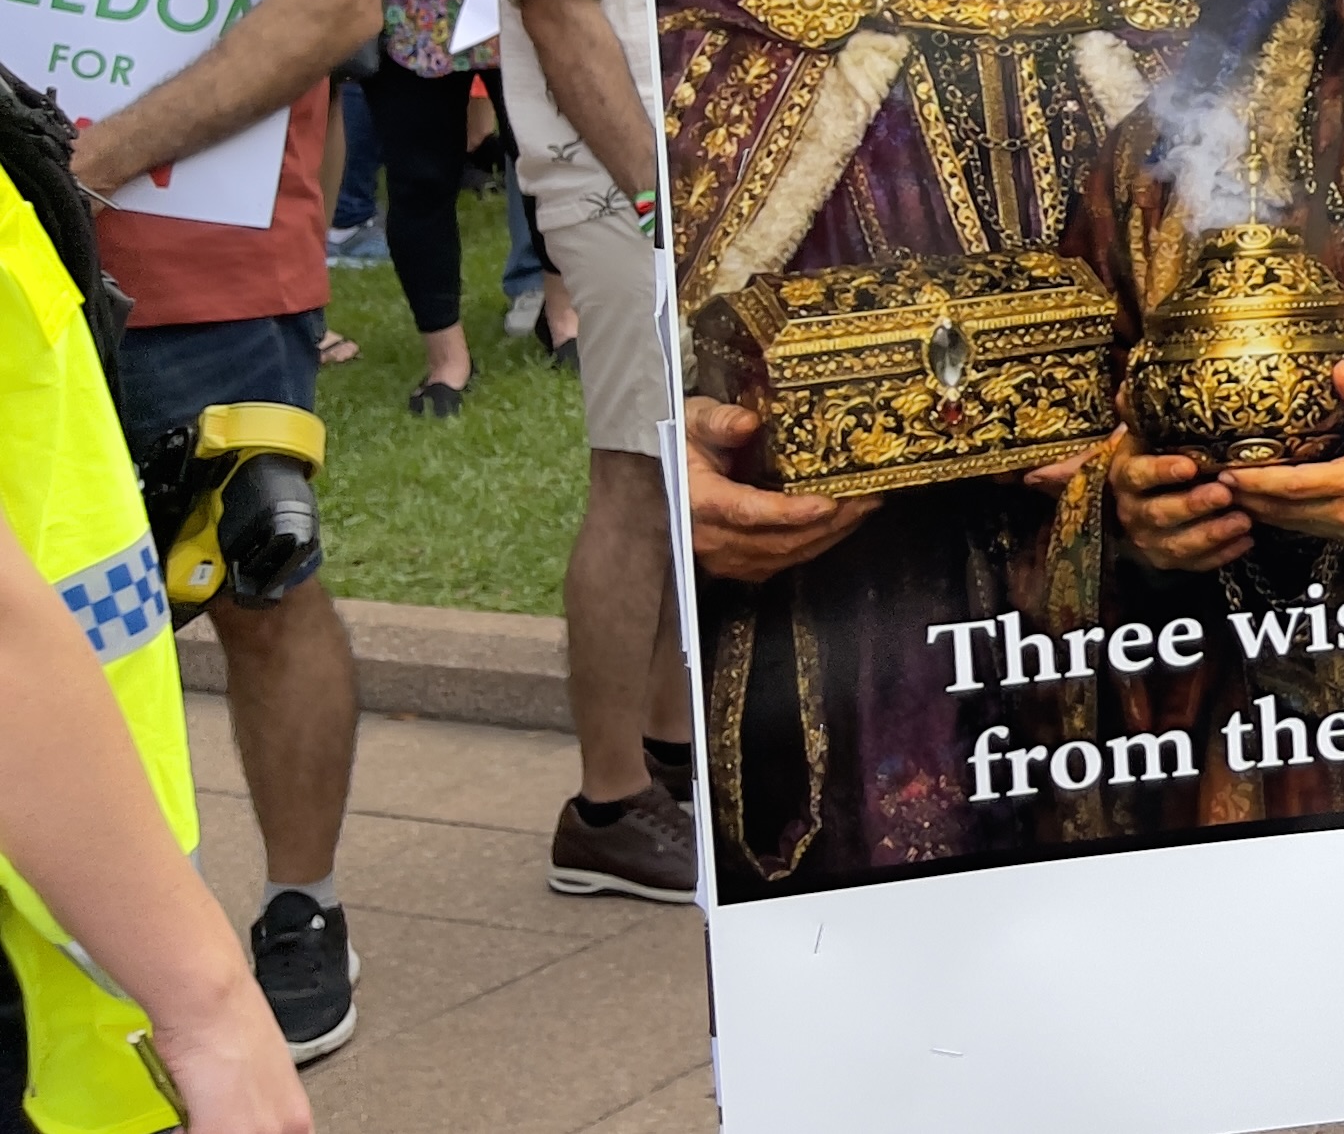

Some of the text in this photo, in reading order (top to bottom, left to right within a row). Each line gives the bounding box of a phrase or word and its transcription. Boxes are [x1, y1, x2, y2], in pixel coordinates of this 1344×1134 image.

[49, 44, 135, 86] FOR
[926, 610, 1204, 693] Three
[967, 725, 1199, 802] from
